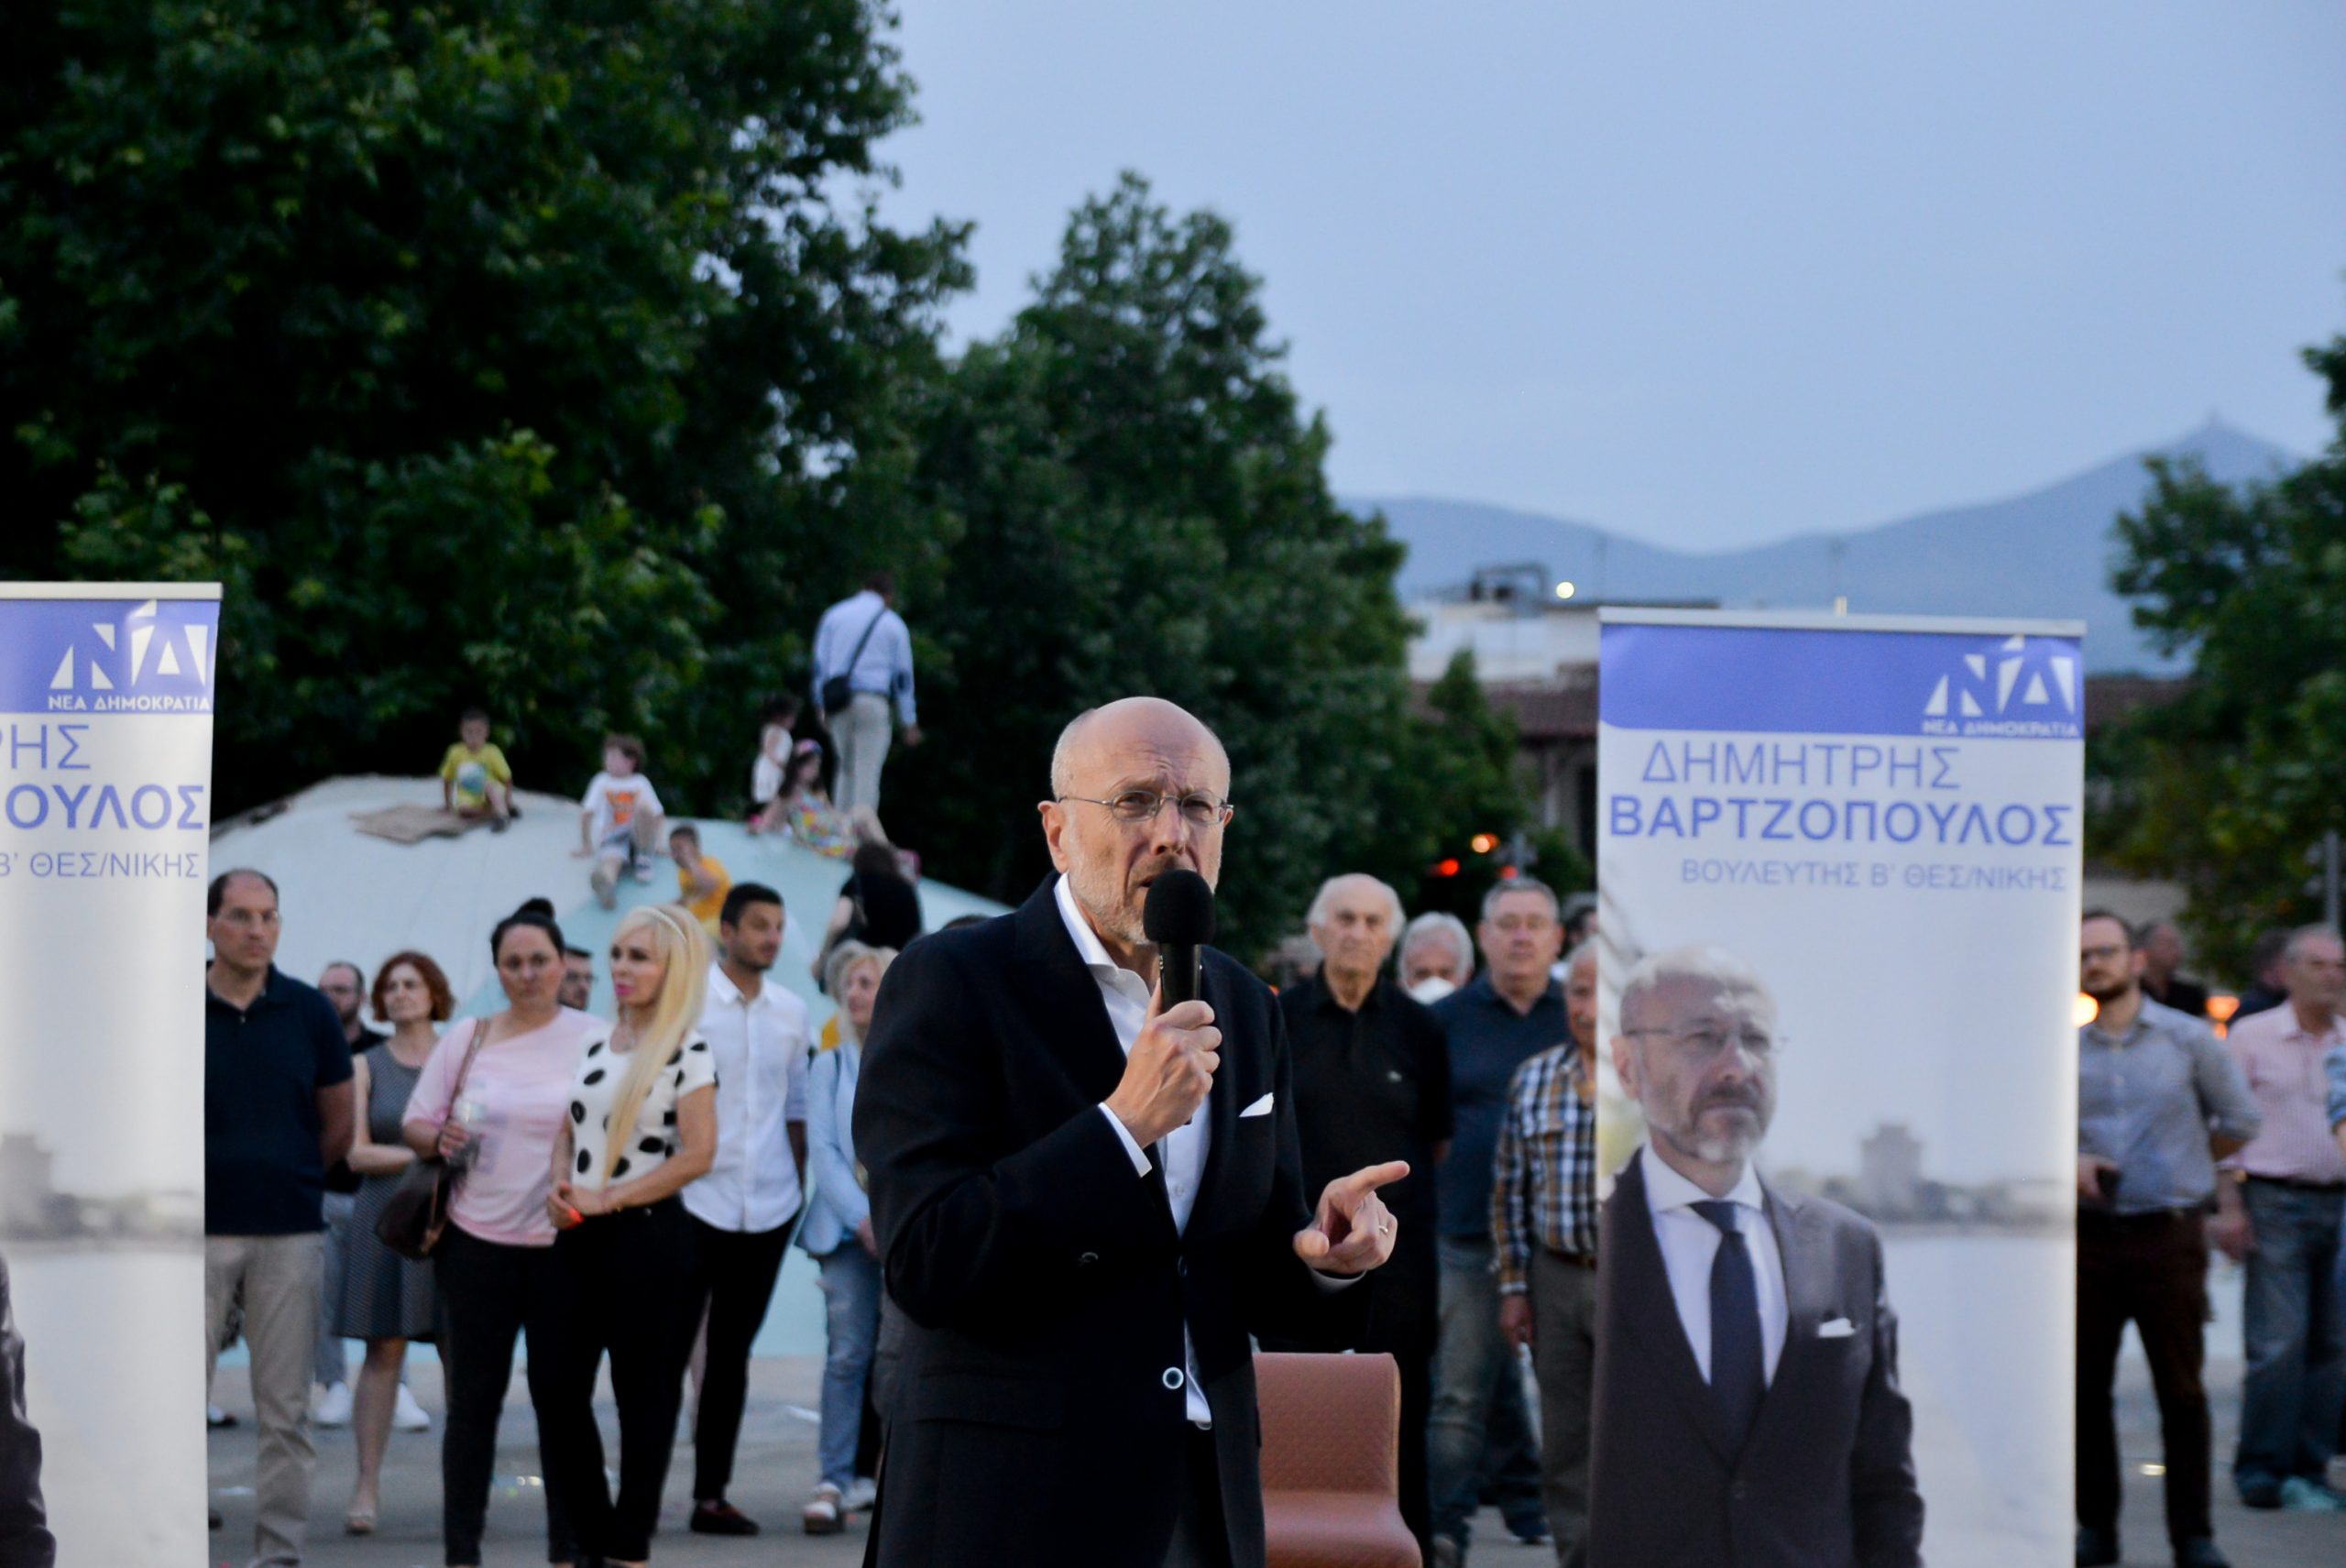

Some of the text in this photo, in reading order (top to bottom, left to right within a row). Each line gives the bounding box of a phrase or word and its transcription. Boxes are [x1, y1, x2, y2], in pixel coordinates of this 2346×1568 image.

[49, 695, 210, 711] ΝΕΑ ΔΗΜΟΚΡΑΤΙΑ
[0, 723, 90, 769] ΗΣ
[1922, 719, 1958, 734] ΝΕΑ
[1641, 740, 1961, 790] ΔΗΜΗΤΡΗΣ
[5, 784, 204, 829] ΟΥΛΟΣ
[1610, 795, 2073, 847] ΒΑΡΤΖΟΠΟΥΛΟΣ
[30, 852, 199, 877] ΘΕΣ/ΝΙΚΗΣ
[1682, 859, 1860, 887] ΒΟΥΛΕΥΤΗΣ
[1903, 864, 2066, 892] ΘΕΣ/ΝΙΚΗΣ
